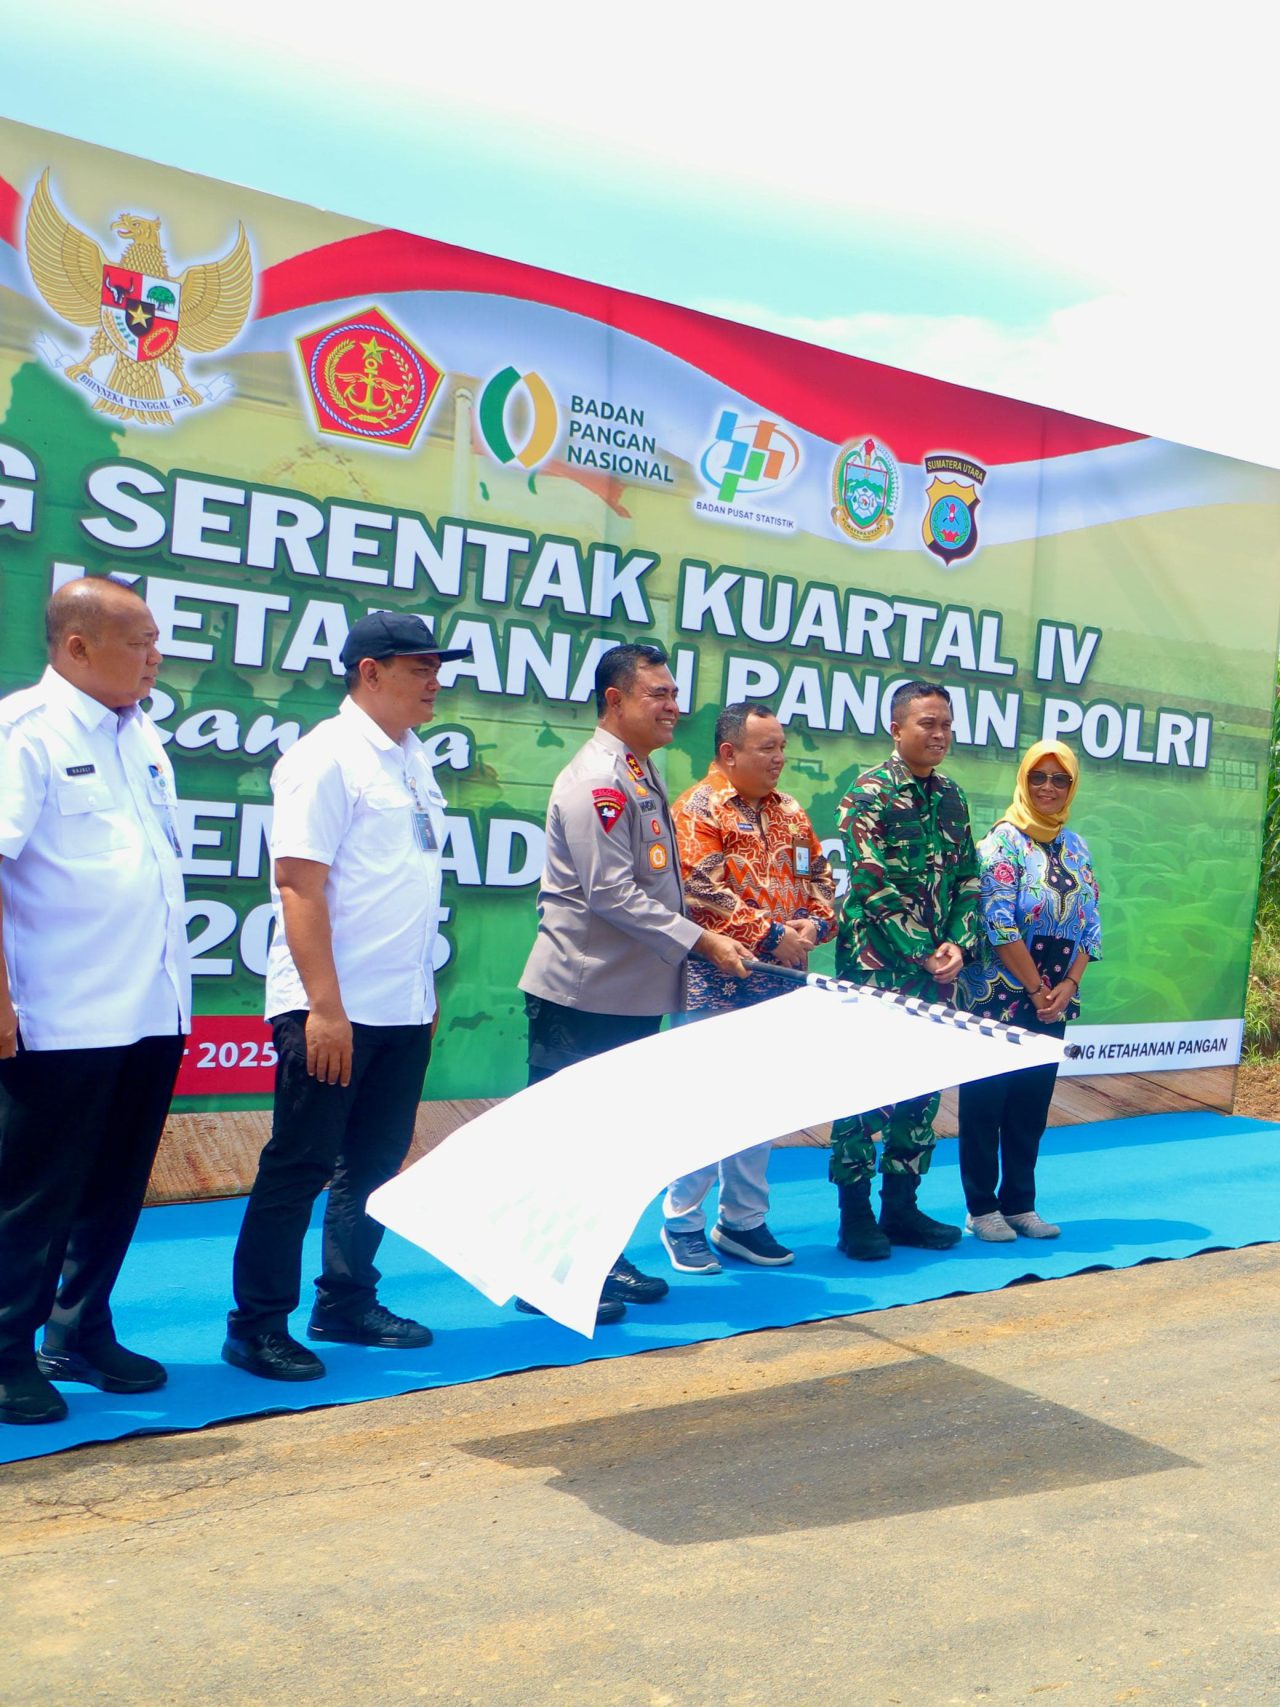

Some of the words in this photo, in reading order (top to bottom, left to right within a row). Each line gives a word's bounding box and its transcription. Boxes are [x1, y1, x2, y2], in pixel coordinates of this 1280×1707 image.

[128, 398, 170, 410] TUNGGAL
[173, 396, 189, 407] IKA
[571, 395, 644, 427] BADAN
[569, 420, 656, 455] PANGAN
[567, 445, 674, 483] NASIONAL
[927, 459, 962, 471] SUMATERA
[962, 465, 984, 481] UTARA
[696, 501, 726, 515] BADAN
[727, 507, 753, 520] PUSAT
[756, 513, 794, 529] STATISTIK
[81, 465, 655, 625] SERENTAK
[681, 565, 1015, 676] KUARTAL
[1037, 625, 1099, 685] IV
[1042, 698, 1210, 768] POLRI
[197, 1041, 278, 1068] 2025
[1098, 1042, 1175, 1059] KETAHANAN
[1177, 1038, 1228, 1054] PANGAN
